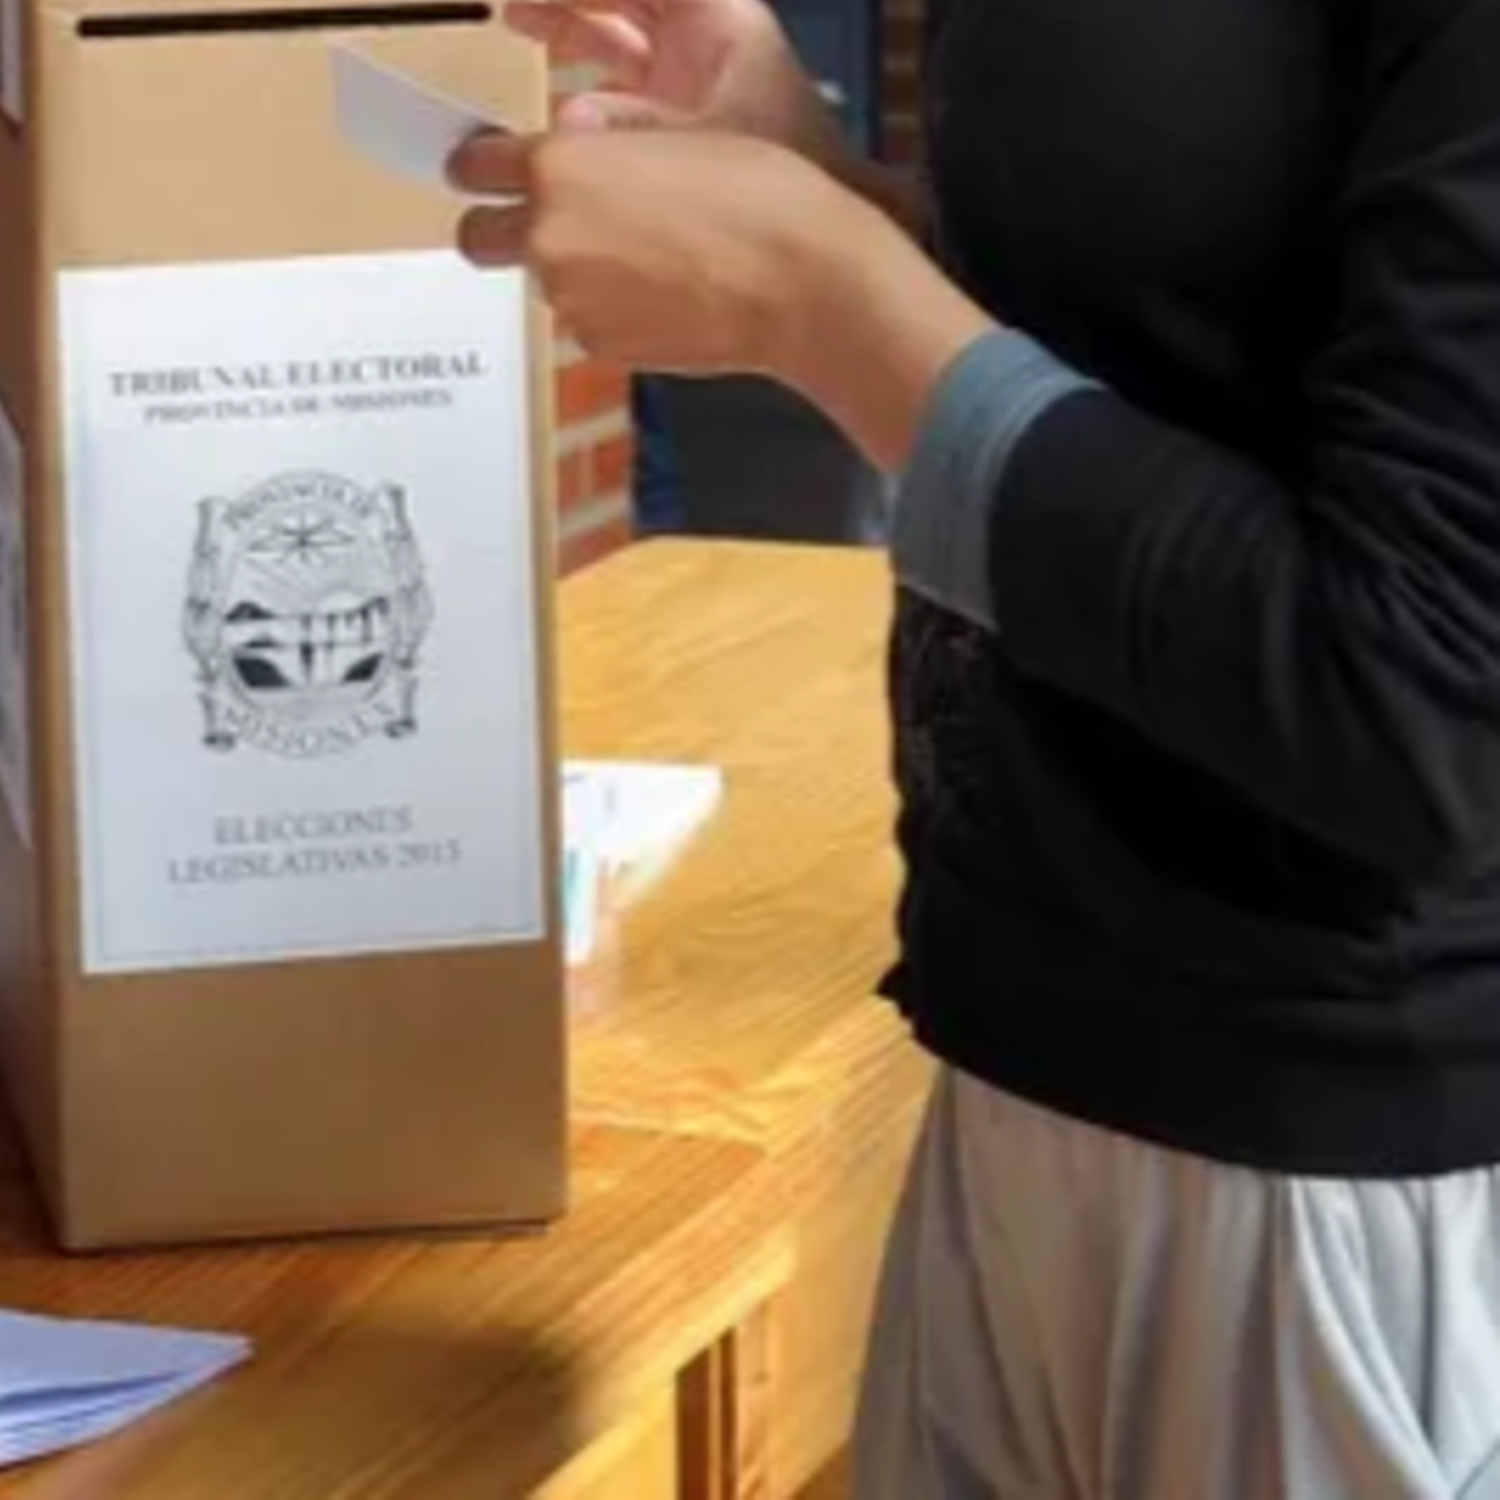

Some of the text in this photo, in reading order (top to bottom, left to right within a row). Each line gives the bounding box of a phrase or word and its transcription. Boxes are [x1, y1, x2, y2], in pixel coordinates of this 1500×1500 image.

[109, 350, 486, 398] TRIBUNAL ELECTORAL
[144, 395, 286, 424] PROVINCIA
[213, 803, 415, 845] ELECCIONES
[168, 844, 392, 885] LEGISLATIVAS
